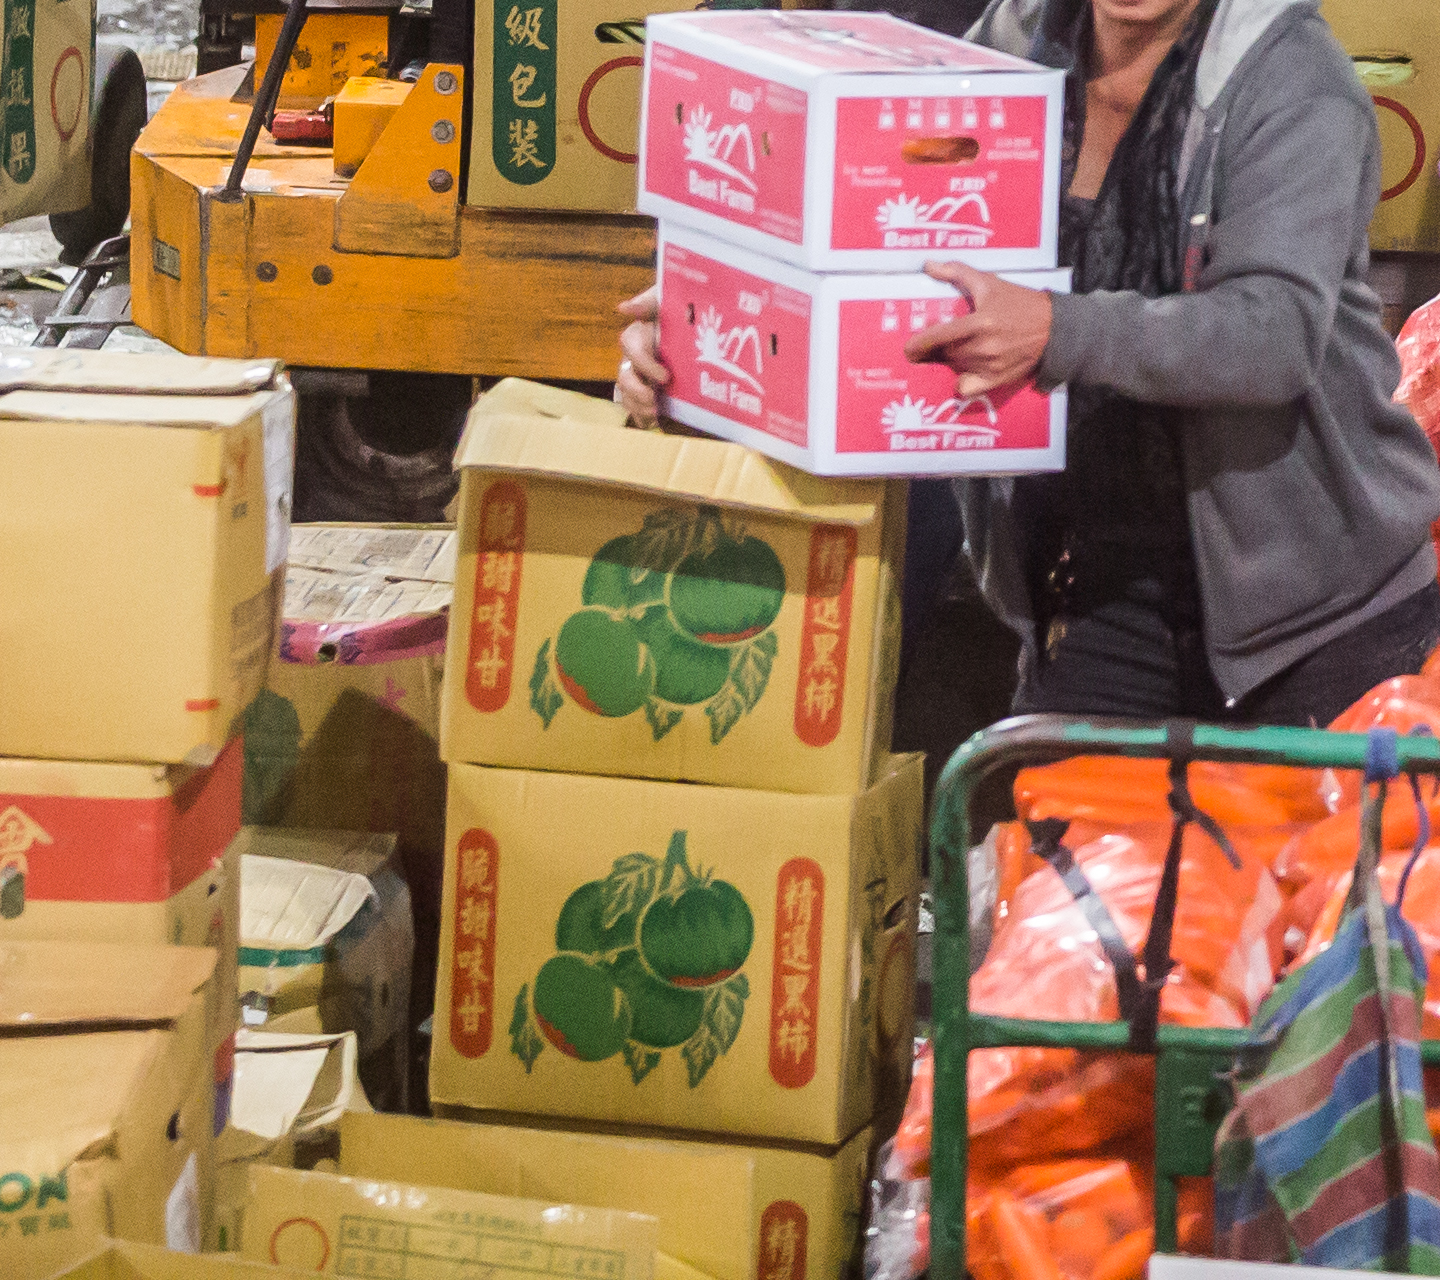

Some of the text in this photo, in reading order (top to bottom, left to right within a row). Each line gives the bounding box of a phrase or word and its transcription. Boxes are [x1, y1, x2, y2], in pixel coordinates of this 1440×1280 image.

[803, 537, 848, 726] 精選黑柿
[455, 838, 496, 1037] 脆甜味甘
[777, 876, 818, 1069] 精選黑柿
